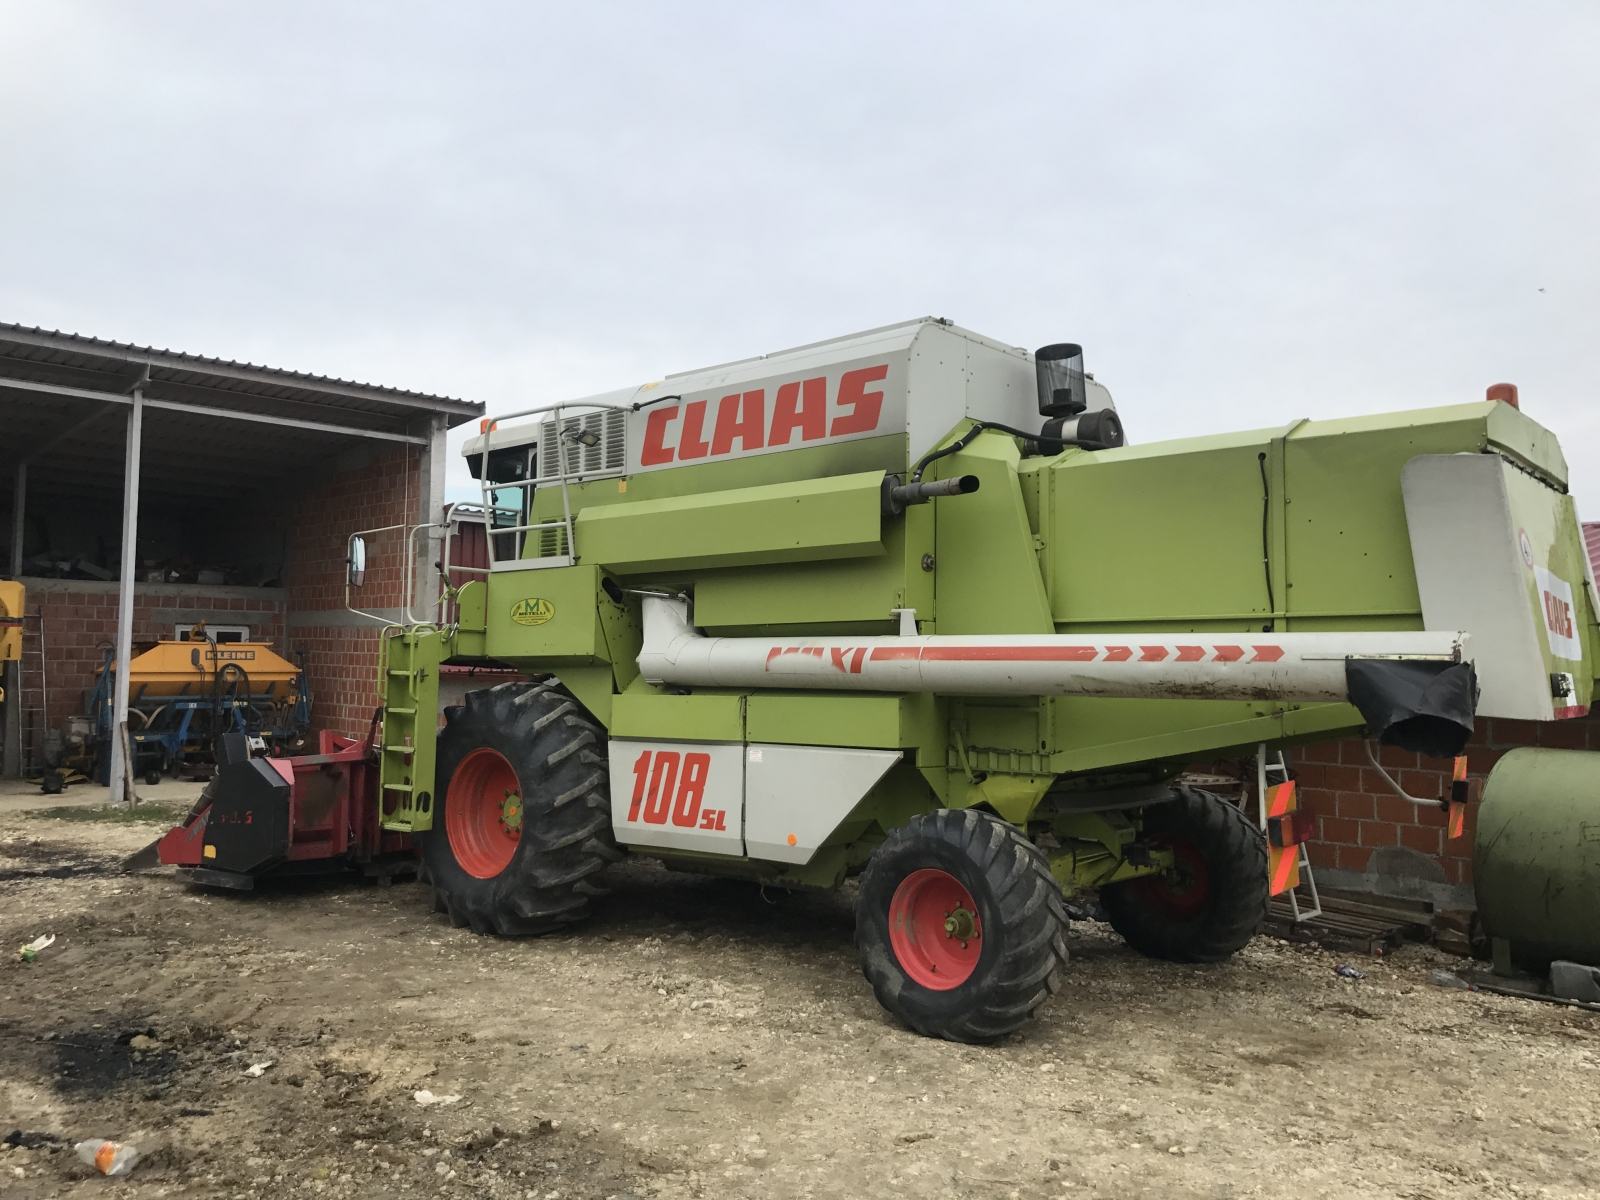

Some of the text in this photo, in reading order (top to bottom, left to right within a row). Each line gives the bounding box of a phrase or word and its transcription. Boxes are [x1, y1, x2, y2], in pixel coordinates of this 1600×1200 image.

[641, 364, 889, 467] CLAAS
[627, 750, 727, 831] 108 SL
